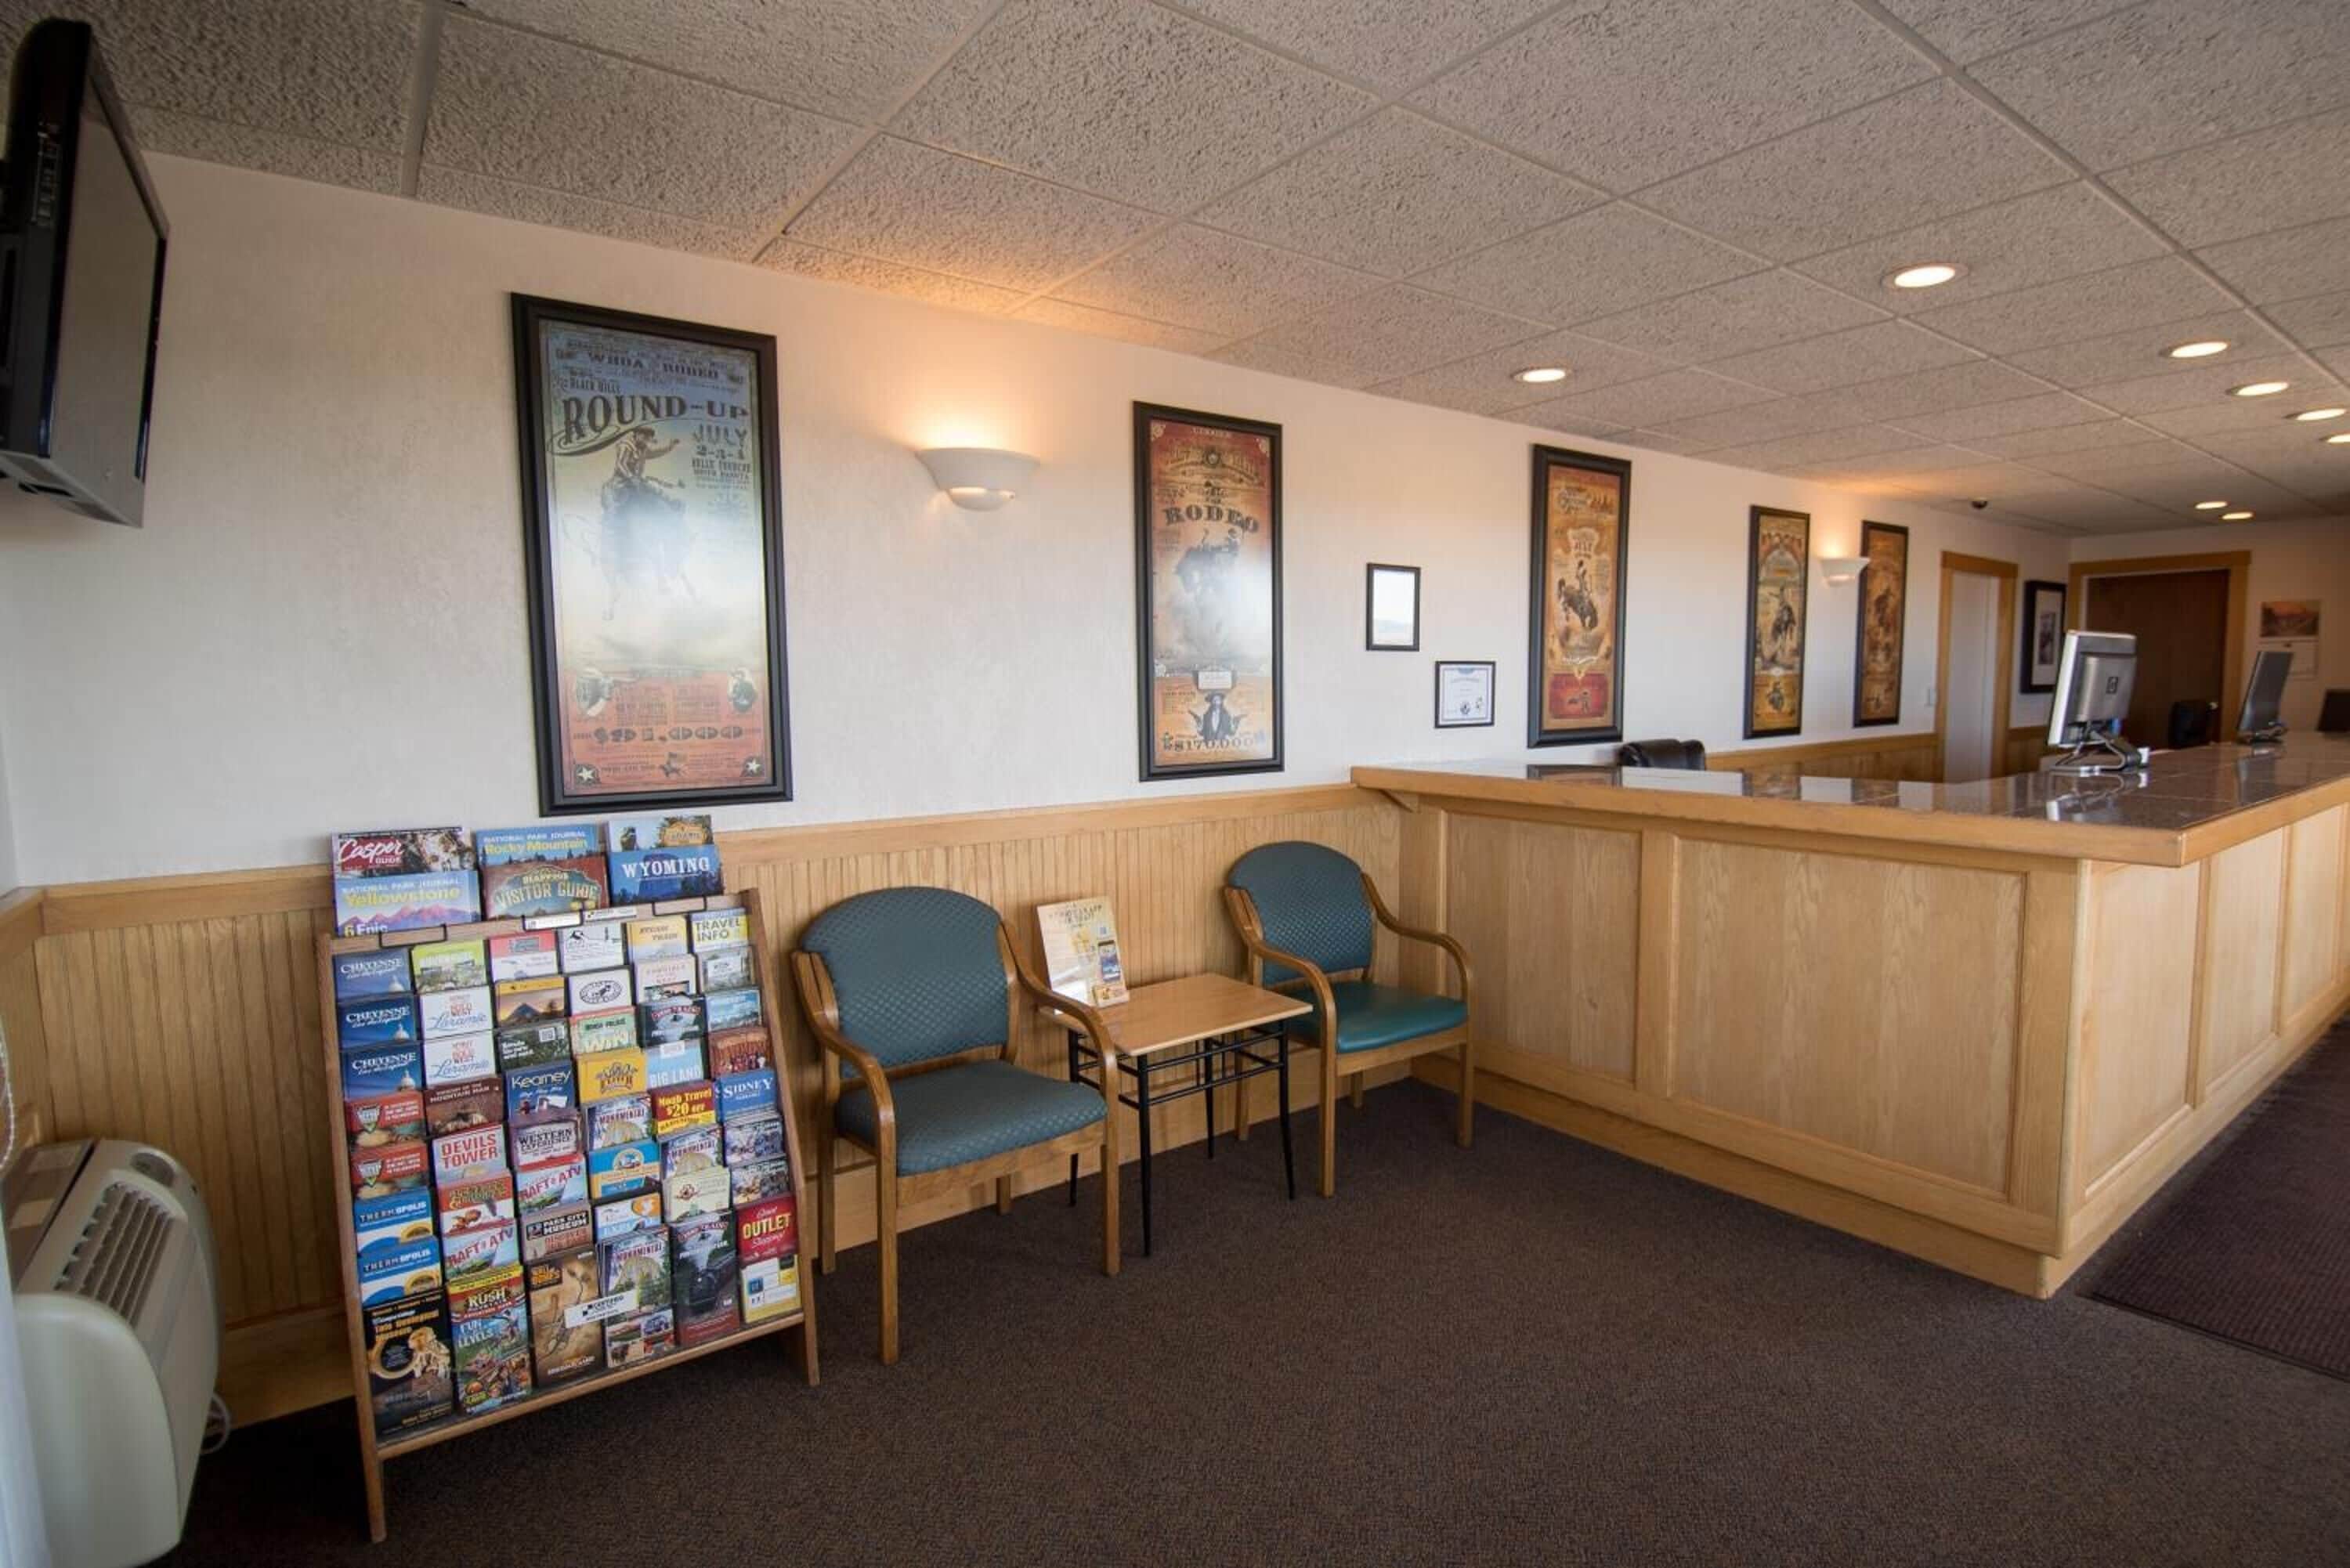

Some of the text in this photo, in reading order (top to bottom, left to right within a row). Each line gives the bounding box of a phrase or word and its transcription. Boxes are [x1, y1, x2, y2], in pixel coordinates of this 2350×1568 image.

[562, 395, 749, 445] ROUND-UP
[692, 424, 747, 448] JULY
[1163, 504, 1260, 533] RODEO
[526, 838, 588, 852] Mountain
[527, 833, 548, 841] PARK
[551, 829, 586, 840] JOURNAL
[338, 836, 405, 865] Casper
[621, 856, 711, 879] WYOMING
[345, 888, 461, 908] Yellowstone
[493, 880, 598, 909] VISITOR GUIDE
[695, 917, 741, 932] TRAVEL
[696, 929, 730, 942] INFO
[340, 958, 403, 974] CHEYENNE
[346, 1006, 410, 1024] CHEYENNE
[352, 1052, 417, 1070] CHEYENNE
[512, 1071, 571, 1089] Kearney
[724, 1077, 773, 1099] SIDNEY
[667, 1102, 690, 1118] $20
[442, 1133, 497, 1156] DEVILS
[519, 1127, 573, 1145] WESTERN
[443, 1147, 499, 1169] TOWER
[519, 1178, 551, 1201] RAFT
[360, 1201, 427, 1223] THERMOPOLIS
[566, 1211, 587, 1221] CITY
[544, 1218, 588, 1236] MUSEUM
[743, 1213, 792, 1239] OUTLET
[446, 1227, 514, 1266] RAFT ATV
[364, 1248, 431, 1271] THERMOPOLIS
[468, 1288, 506, 1308] RUSH
